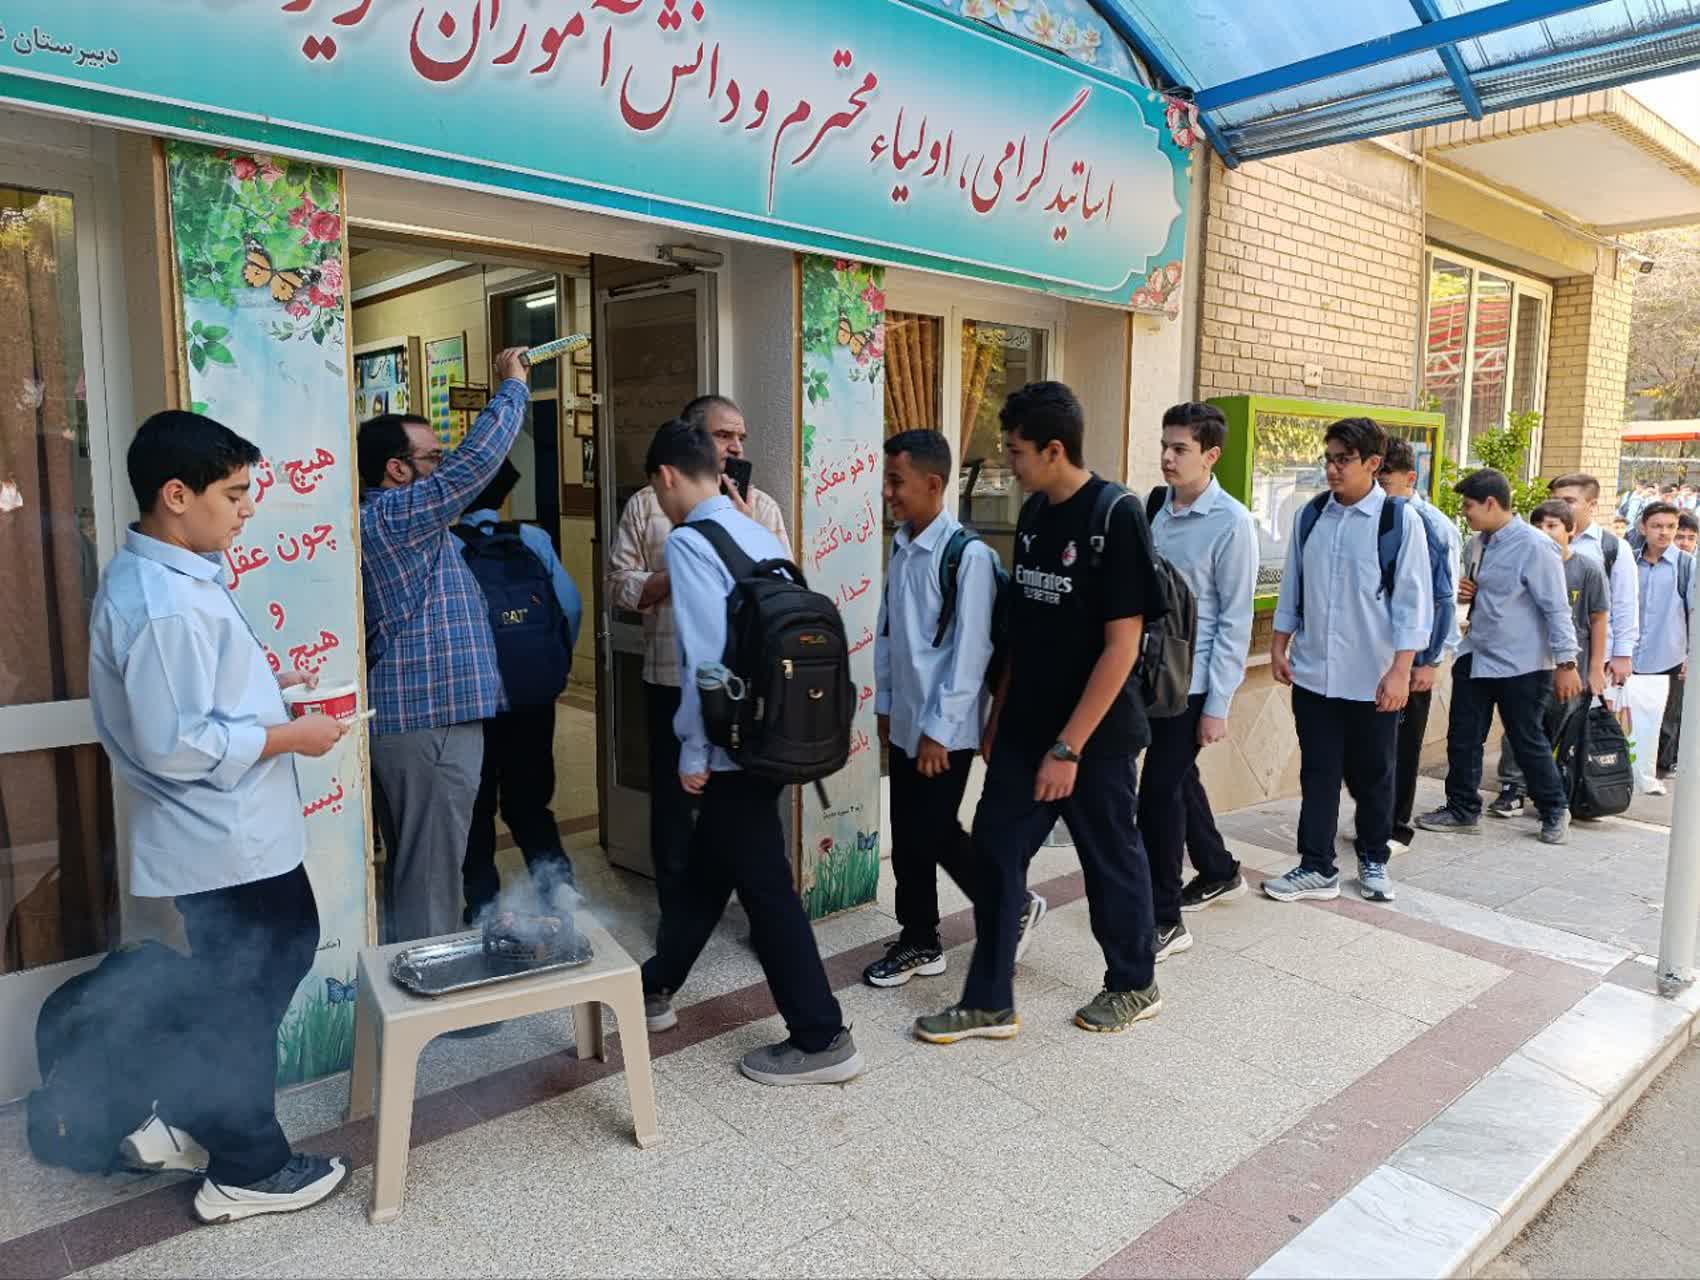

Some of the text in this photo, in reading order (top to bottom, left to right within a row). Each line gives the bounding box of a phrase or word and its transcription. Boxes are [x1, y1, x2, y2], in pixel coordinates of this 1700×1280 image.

[13, 27, 119, 68] دبیرستان
[767, 48, 878, 214] محترم
[868, 105, 953, 203] اولیاء
[1044, 159, 1115, 241] اساتید
[284, 447, 336, 495] هیچ
[224, 524, 337, 591] چون عقل
[1015, 564, 1073, 593] Emirates
[269, 601, 286, 630] و
[502, 608, 528, 625] CAT
[288, 630, 340, 674] هیچ
[303, 776, 345, 818] نیس
